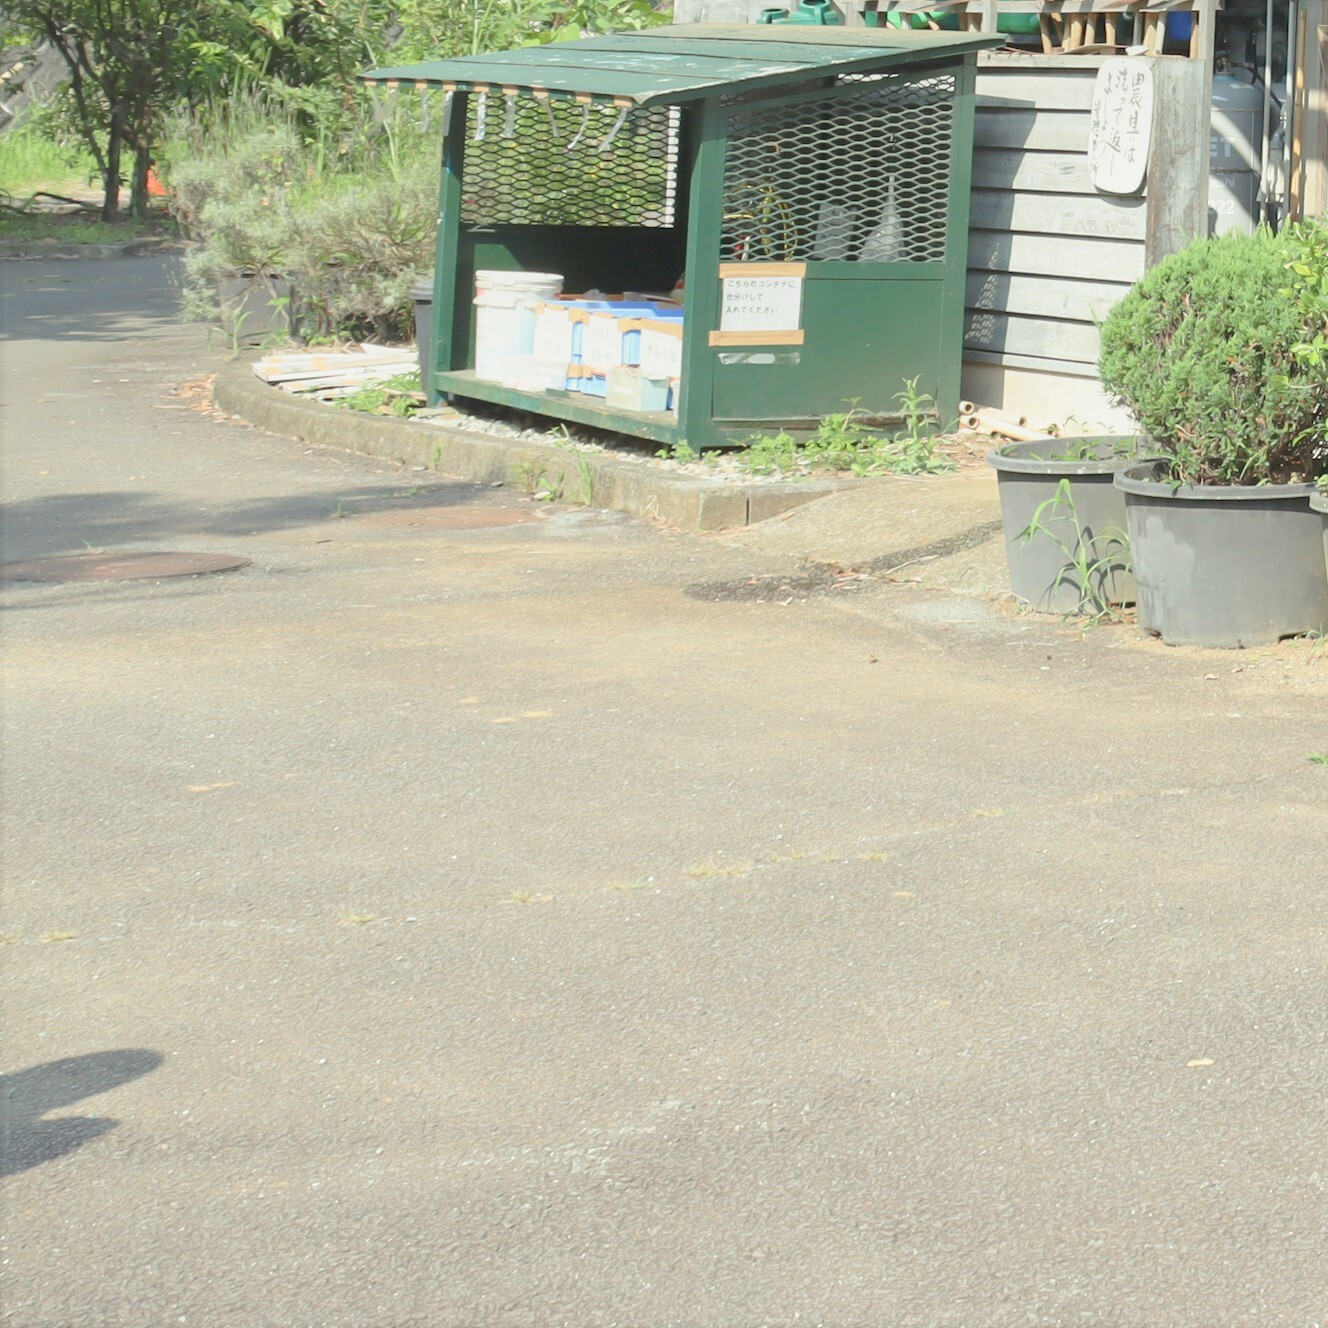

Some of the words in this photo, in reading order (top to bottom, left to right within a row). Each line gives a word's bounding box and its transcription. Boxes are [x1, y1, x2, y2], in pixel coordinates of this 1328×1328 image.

[728, 280, 796, 288] こちらのコンテナに
[727, 293, 764, 301] 仕分けして
